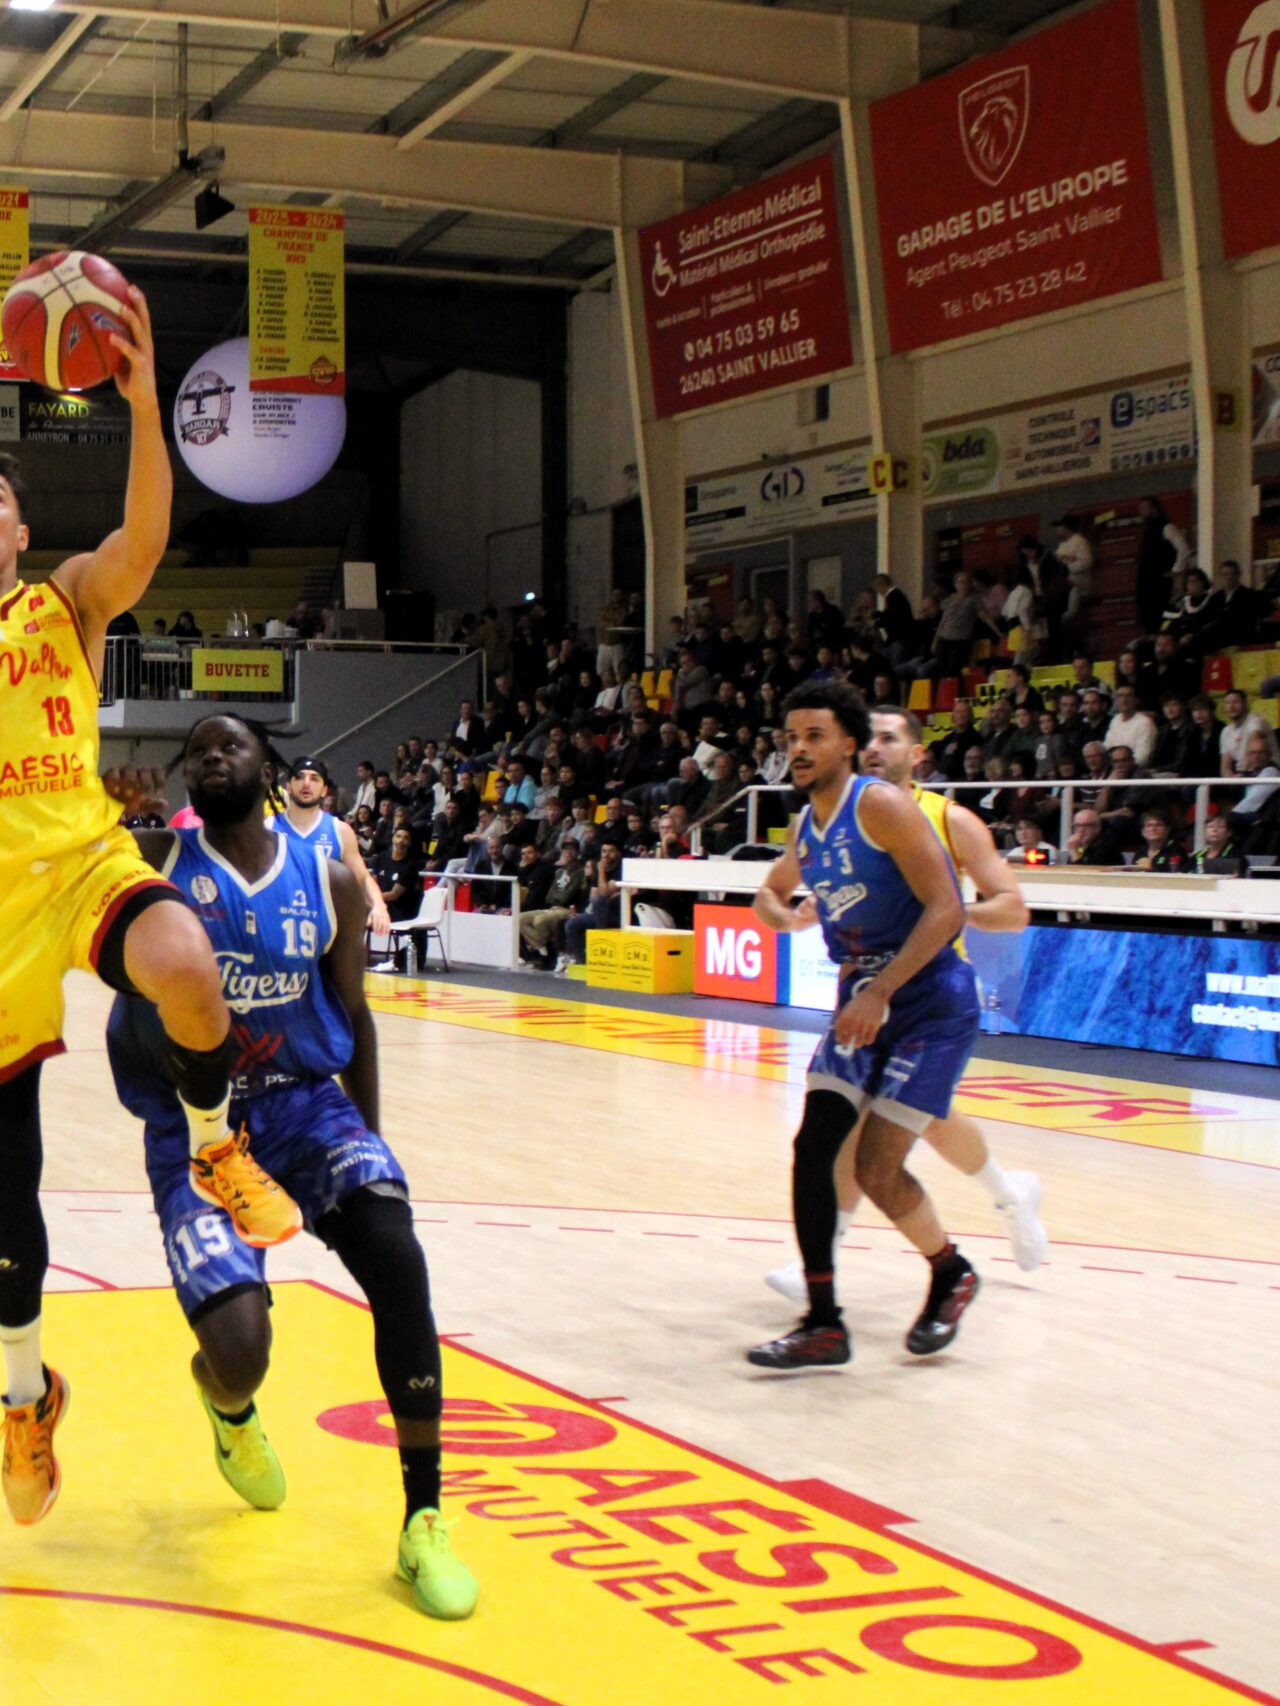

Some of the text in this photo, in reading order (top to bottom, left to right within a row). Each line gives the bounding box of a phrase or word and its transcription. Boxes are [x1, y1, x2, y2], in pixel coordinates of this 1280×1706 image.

[0, 210, 12, 221] DE
[765, 175, 822, 220] Médical
[897, 159, 1129, 257] GARAGE DE L'EUROPE
[264, 228, 312, 240] CHAMPION
[277, 241, 315, 252] FRANCE
[906, 204, 1123, 288] Agent Peugeot Saint Vallier
[994, 285, 1015, 306] 75
[1017, 277, 1038, 298] 23
[1065, 261, 1087, 284] 42
[696, 308, 800, 359] 04 75 03 59 65
[719, 354, 756, 383] SAINT
[758, 338, 816, 371] VALLIER
[28, 402, 90, 419] FAYARD
[26, 432, 70, 442] ANNEYRON
[873, 460, 886, 489] C
[894, 460, 908, 488] C
[204, 662, 270, 678] BUVETTE
[41, 696, 75, 737] 13
[281, 918, 318, 958] 19
[705, 927, 762, 978] MG
[175, 1212, 233, 1270] 19
[440, 1467, 870, 1685] MUTUELLE
